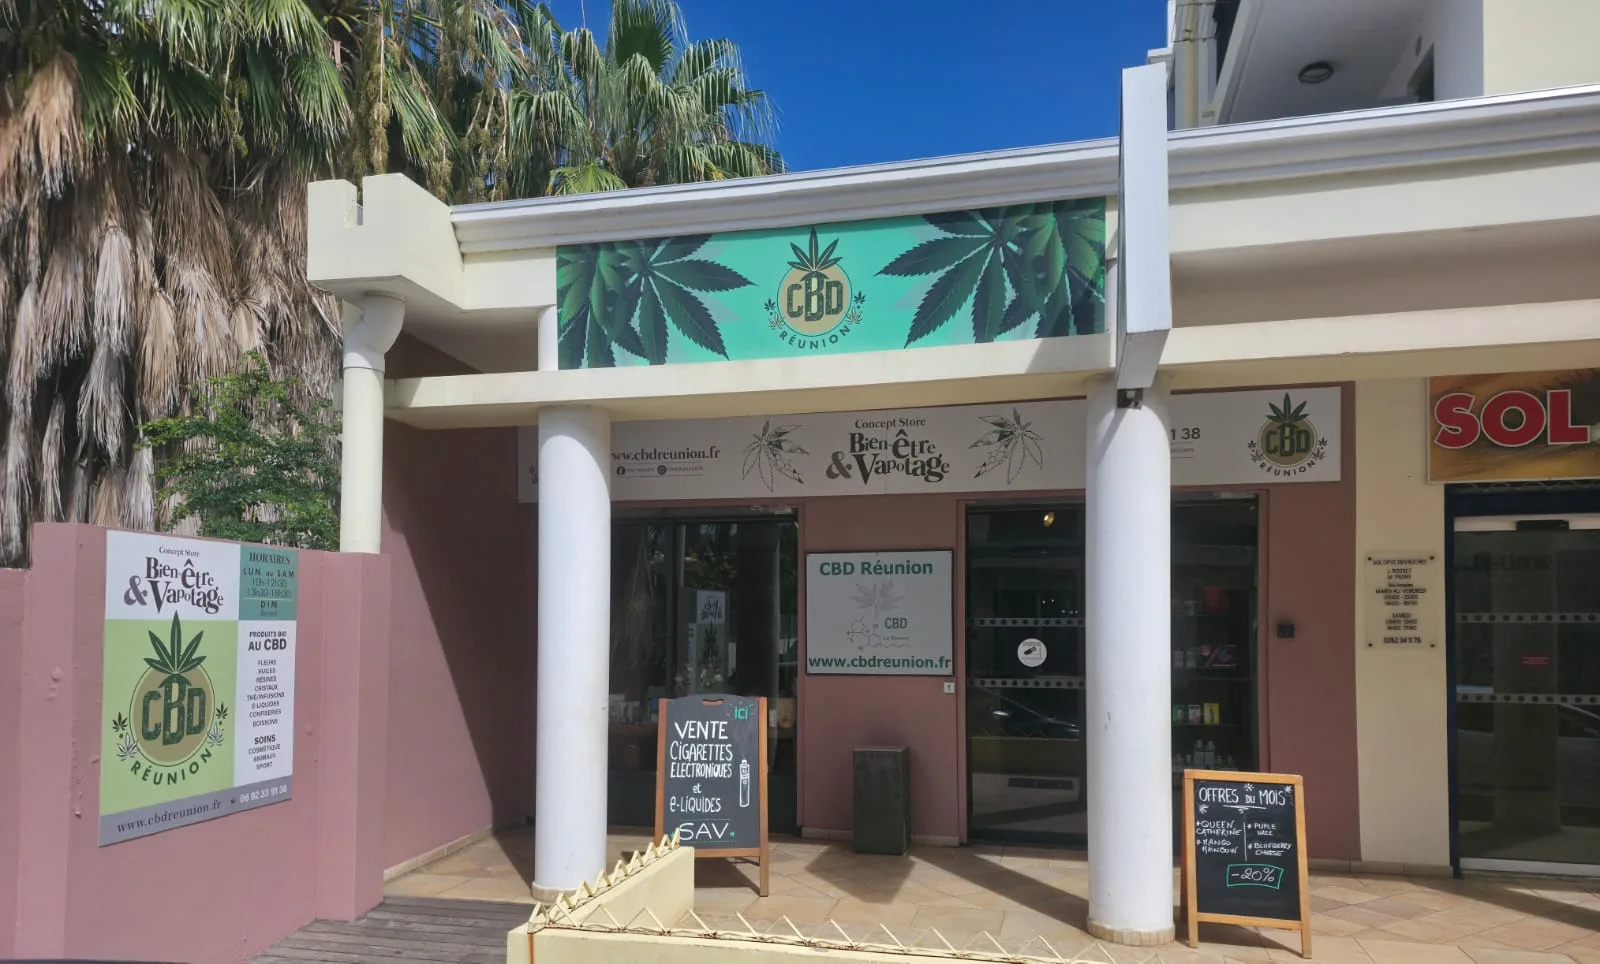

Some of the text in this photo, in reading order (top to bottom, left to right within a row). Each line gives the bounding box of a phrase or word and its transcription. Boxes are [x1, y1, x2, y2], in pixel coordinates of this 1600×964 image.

[787, 271, 843, 322] CBD
[779, 325, 850, 349] RÉUNION
[854, 417, 926, 429] Concept Store
[1434, 389, 1591, 449] SOL
[1181, 427, 1201, 440] 38
[1265, 422, 1311, 457] CBD
[848, 429, 936, 459] Bien-être
[610, 445, 721, 461] ww.cbdreunion.fr
[825, 451, 950, 486] & Vapotage
[1259, 459, 1316, 477] RÉUNION
[159, 546, 200, 557] Concept Store
[249, 552, 291, 565] HORAIRES
[145, 556, 214, 589] Bien-être
[243, 567, 261, 576] LUN
[277, 570, 295, 578] SAM
[819, 559, 934, 576] CBD Réunion
[123, 575, 224, 614] & Vapotage
[260, 600, 278, 609] DIM
[884, 617, 908, 629] CBD
[248, 638, 287, 651] AU CBD
[808, 655, 952, 669] www.cbdreunion.fr
[256, 675, 277, 683] RÉSINES
[141, 673, 206, 746] CBD
[249, 709, 282, 718] CONFISERIES
[252, 718, 278, 727] BOISSONS
[674, 720, 729, 740] VENTE
[254, 734, 276, 745] SOINS
[130, 748, 212, 786] RÉUNION
[256, 761, 273, 770] SPORT
[239, 784, 288, 803] 06 92 33 91 38
[692, 782, 702, 794] et
[1198, 787, 1286, 806] OFFRES DU MOIS
[116, 799, 222, 833] www.cbdreunion.fr
[679, 822, 729, 841] SAV
[1200, 820, 1235, 829] QUEEN
[1195, 828, 1242, 837] CATHERINE
[1202, 838, 1232, 846] MANGO
[1231, 867, 1275, 882] -20%
